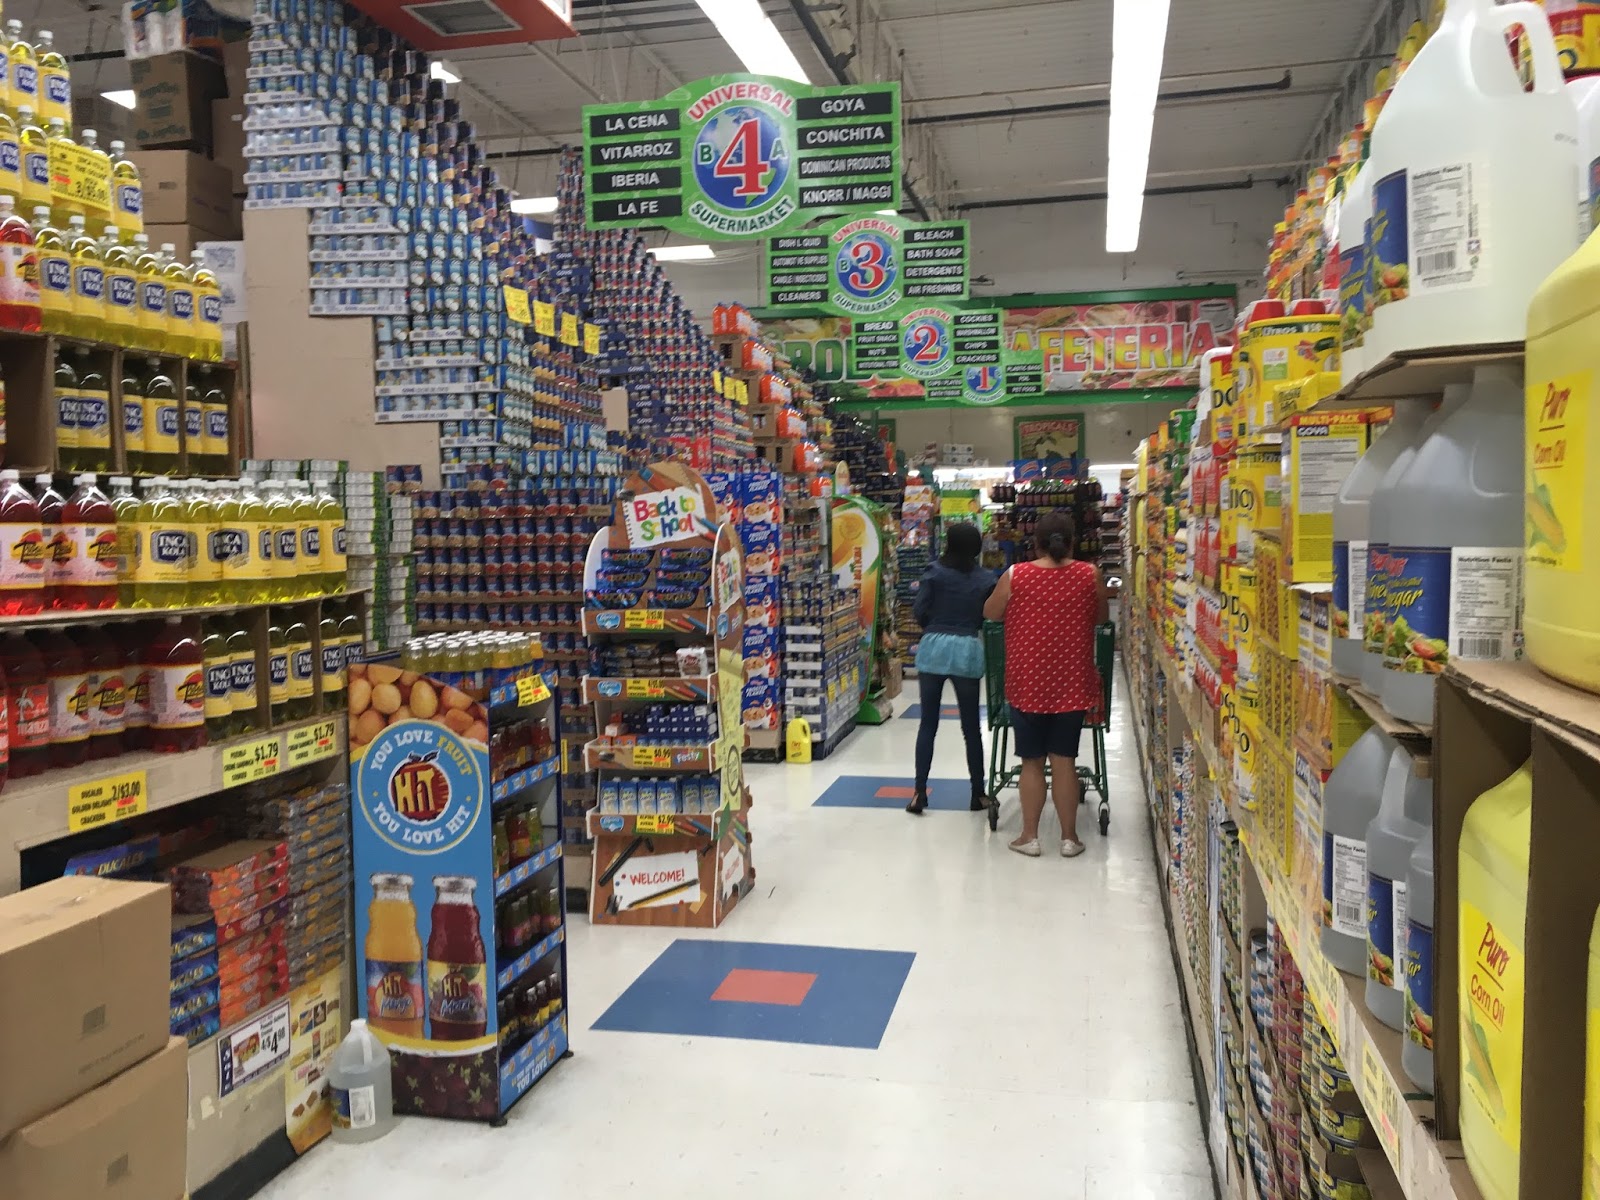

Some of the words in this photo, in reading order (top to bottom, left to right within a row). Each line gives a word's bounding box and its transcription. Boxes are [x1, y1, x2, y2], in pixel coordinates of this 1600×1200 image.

[688, 83, 795, 121] UNIVERSAL
[821, 98, 866, 113] GOYA
[605, 115, 626, 131] LA
[628, 113, 669, 129] CENA
[806, 127, 885, 143] CONCHITA
[600, 142, 673, 160] VITARROZ
[700, 144, 713, 164] B
[714, 118, 770, 197] 4
[771, 139, 787, 160] A
[801, 158, 847, 174] DOMINICAN
[848, 155, 891, 171] PRODUCTS
[611, 174, 660, 188] IBERIA
[803, 189, 844, 204] KNORR
[852, 185, 892, 200] MAGGI
[617, 202, 638, 216] LA
[640, 200, 659, 214] FE
[690, 197, 795, 233] SUPERMARKET
[832, 218, 901, 243] UNIVERSAL
[913, 230, 954, 241] BLEACH
[907, 249, 935, 260] BATH
[935, 247, 963, 258] SOAP
[839, 257, 850, 273] B
[849, 241, 884, 291] 3
[906, 265, 963, 277] DETERGENTS
[778, 291, 822, 302] CLEANERS
[908, 285, 921, 295] AIR
[922, 283, 963, 294] FRESHNER
[832, 289, 902, 314] SUPERMARKET
[901, 308, 951, 326] UNIVERSAL
[960, 315, 994, 324] COOKIES
[864, 322, 894, 331] BREAD
[858, 336, 875, 344] FRUIT
[876, 334, 897, 342] SNACK
[913, 325, 941, 361] 2
[964, 342, 988, 350] CHIPS
[956, 355, 997, 364] CRACKERS
[902, 360, 953, 378] SUPERMARKET
[977, 367, 991, 391] 1
[1299, 414, 1359, 426] MULTI-PACK
[1297, 426, 1329, 436] GOYA
[634, 496, 678, 522] Back
[679, 494, 696, 513] to
[640, 513, 695, 541] School
[1492, 556, 1512, 564] Facts
[314, 722, 335, 741] $1.79
[255, 742, 279, 764] $1.79
[371, 741, 393, 770] YOU
[395, 729, 433, 746] LOVE
[437, 736, 473, 775] FRUIT
[112, 780, 140, 801] 2/$3.00
[373, 801, 401, 833] YOU
[402, 828, 444, 845] LOVE
[446, 805, 471, 835] HIT
[98, 852, 144, 875] DUCALES
[630, 868, 685, 886] WELCOME!
[1478, 922, 1511, 977] Puro
[1471, 974, 1491, 1012] Corn
[1492, 998, 1506, 1027] Oil
[517, 1073, 530, 1093] YOU
